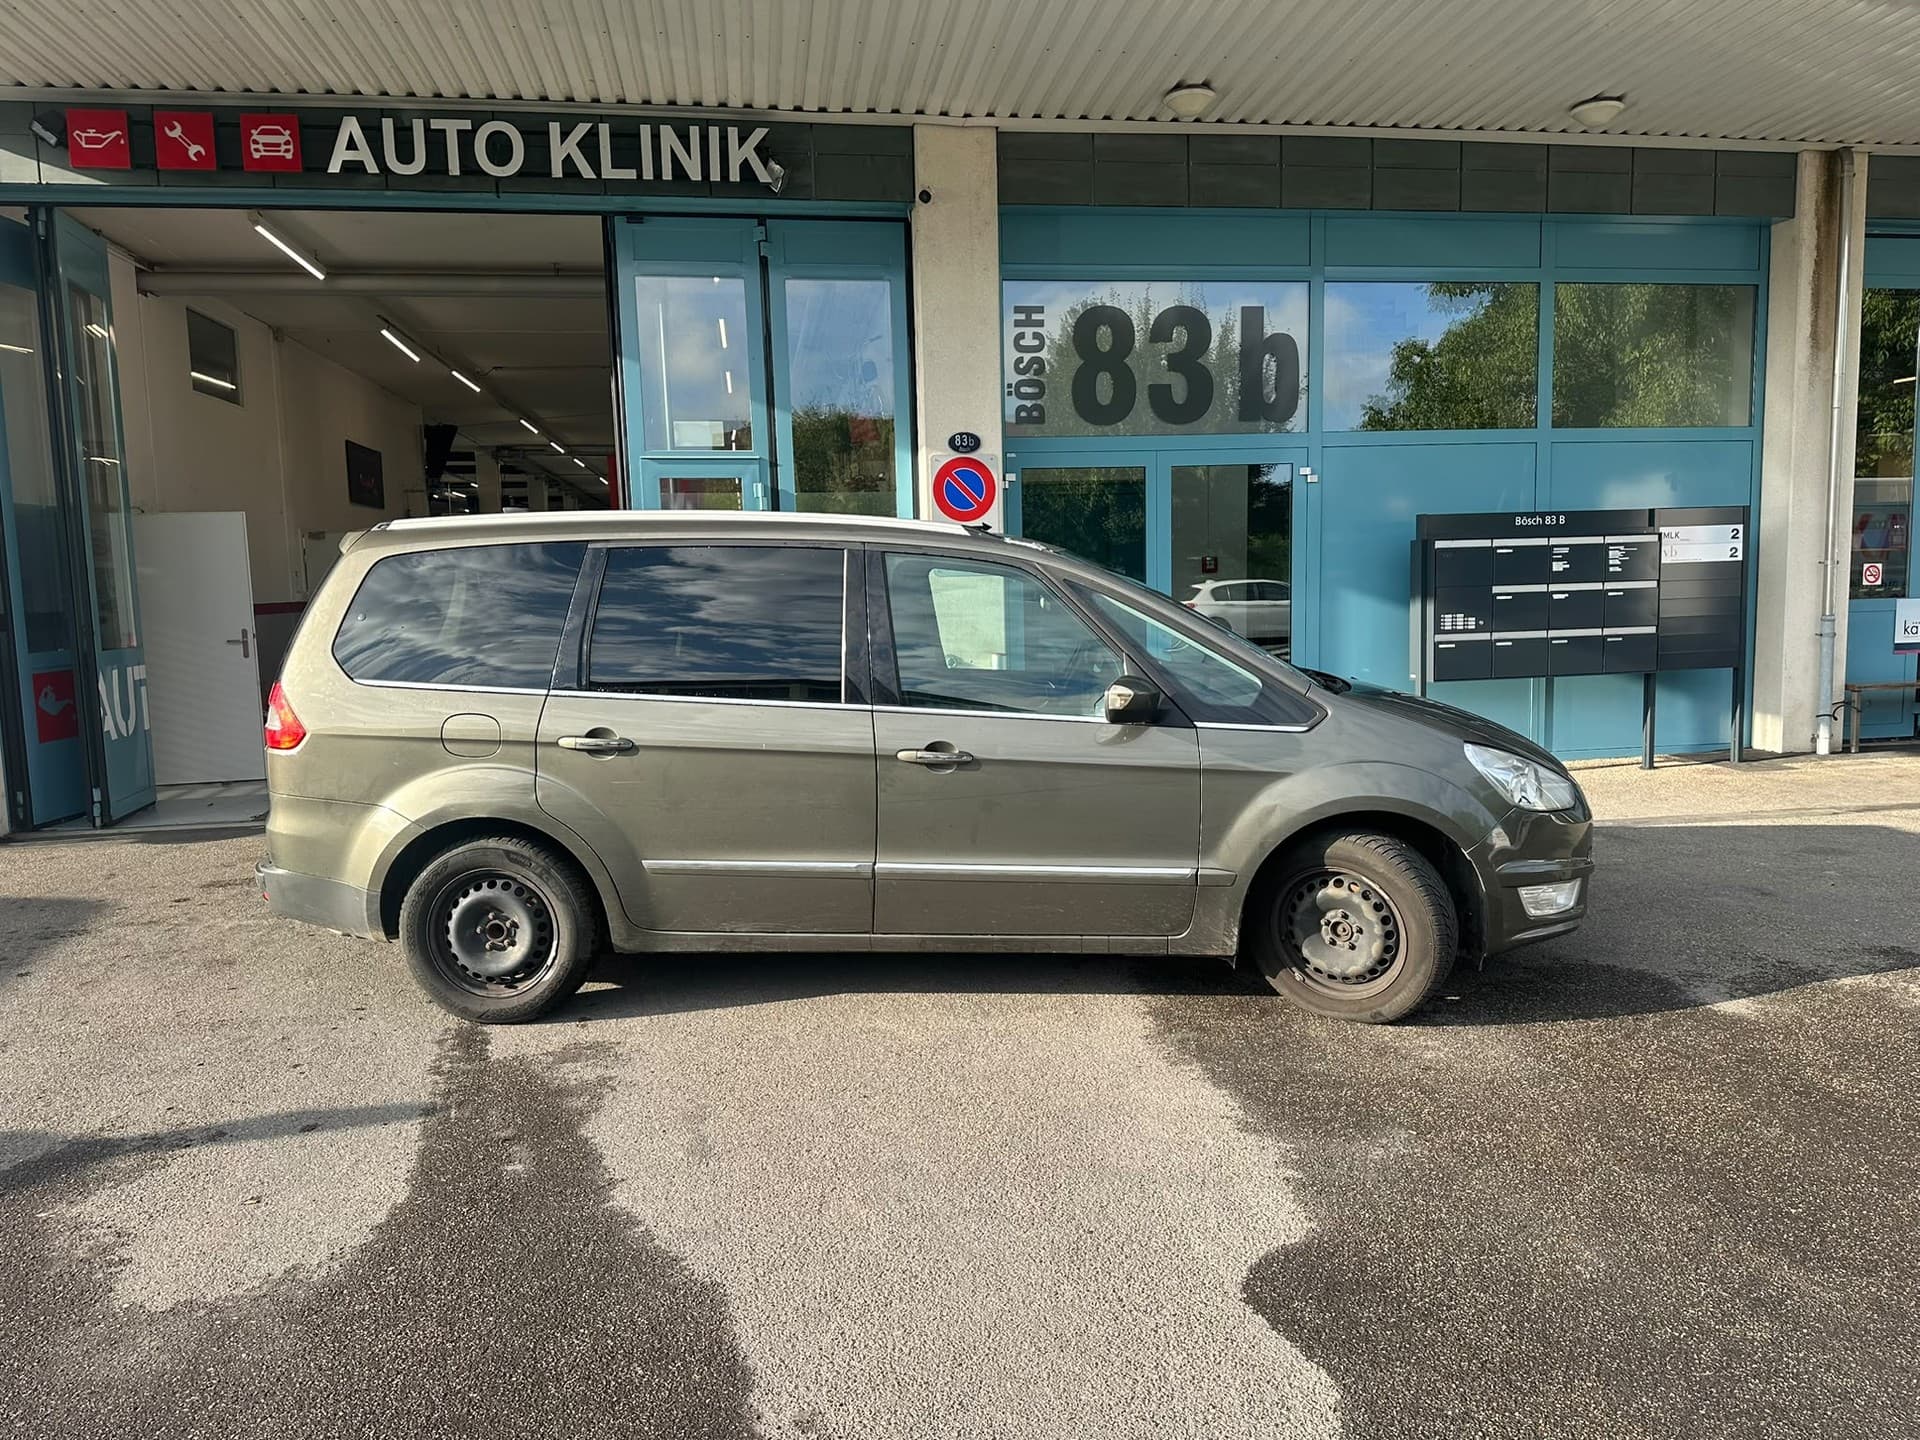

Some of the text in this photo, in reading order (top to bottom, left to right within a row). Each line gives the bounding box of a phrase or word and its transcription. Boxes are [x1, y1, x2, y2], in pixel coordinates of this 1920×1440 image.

[327, 116, 771, 183] AUTO KLINIK
[1007, 305, 1046, 425] BÖSCH
[954, 434, 975, 446] 83b
[1544, 515, 1557, 525] 83
[1559, 514, 1566, 525] B
[1663, 528, 1740, 540] MLK 2
[1729, 547, 1738, 558] 2
